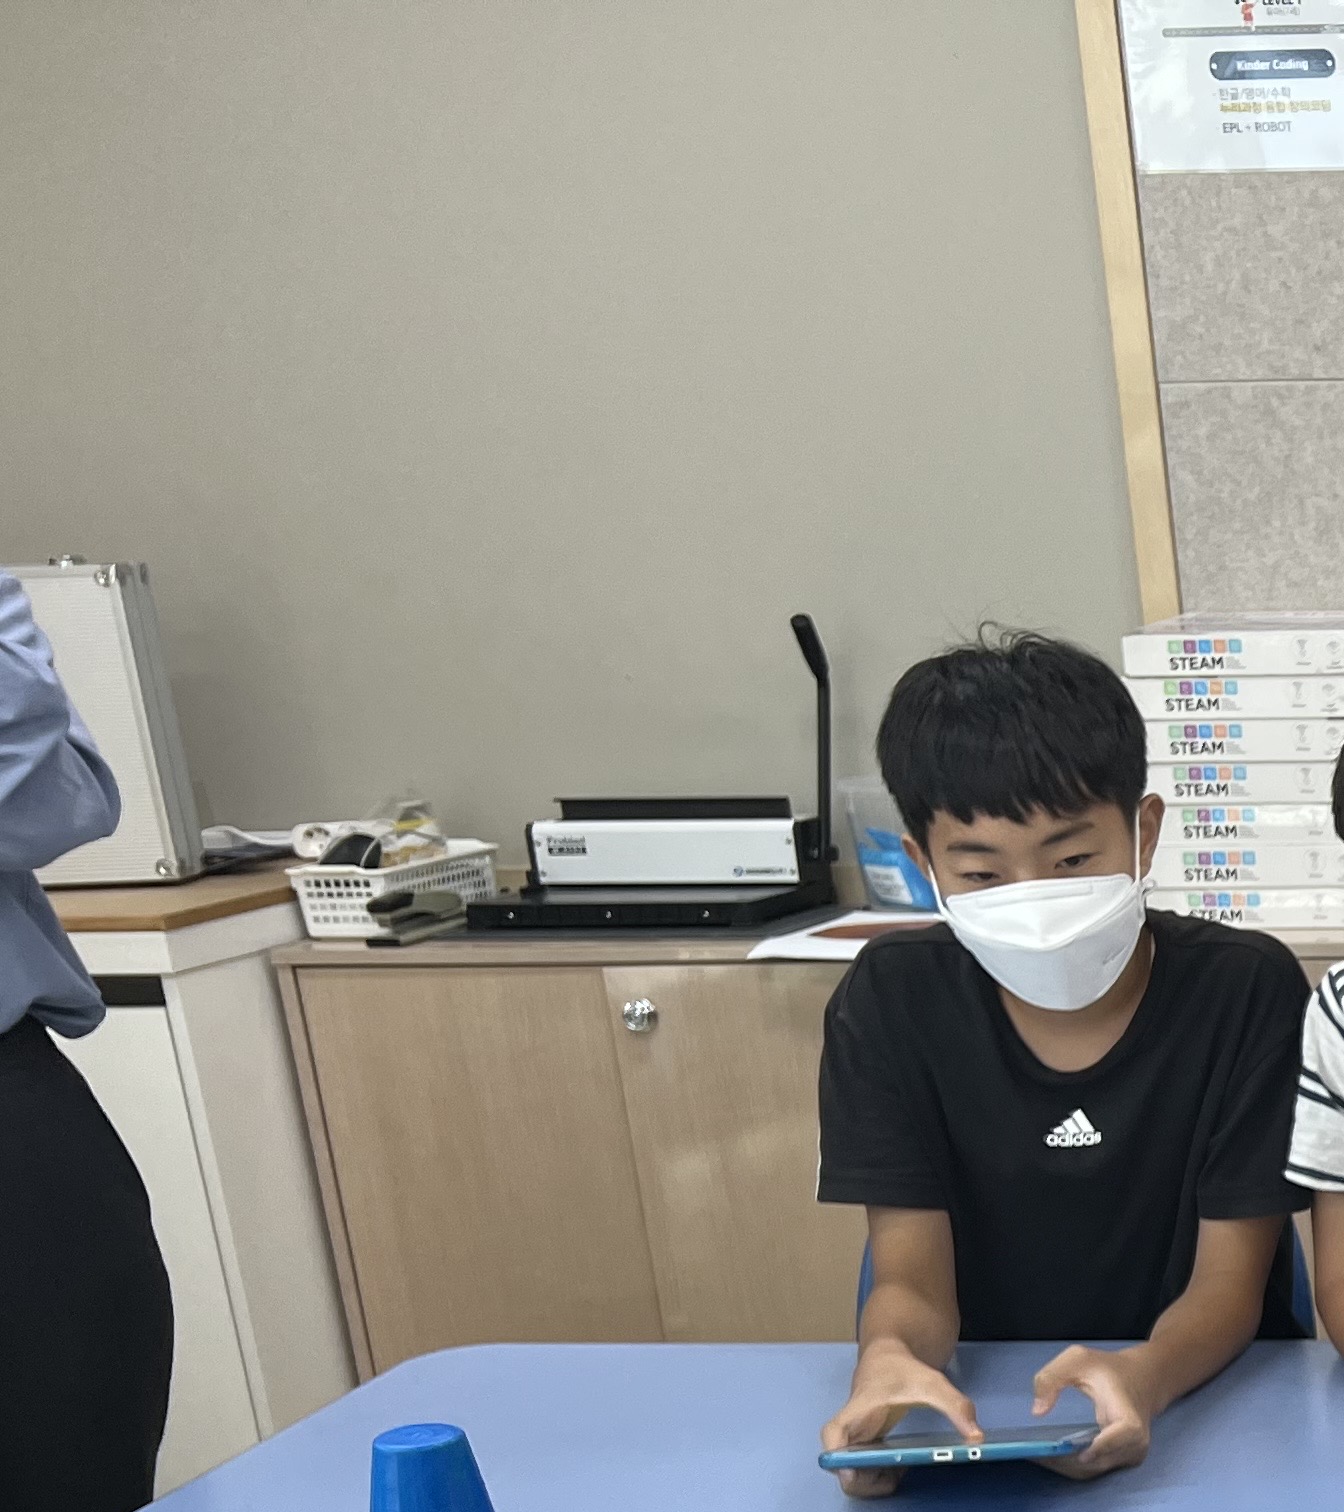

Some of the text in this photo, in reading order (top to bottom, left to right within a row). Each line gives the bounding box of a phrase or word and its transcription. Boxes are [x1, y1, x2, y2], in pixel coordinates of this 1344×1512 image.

[1272, 59, 1309, 71] Coding
[1222, 122, 1243, 133] EPL
[1254, 121, 1292, 133] ROBOT
[1169, 656, 1225, 671] STEAM
[1165, 698, 1220, 712] STEAM
[1170, 741, 1225, 755] STEAM
[1174, 783, 1229, 797] STEAM
[1183, 825, 1238, 839] STEAM
[1184, 868, 1238, 882] STEAM
[1044, 1131, 1102, 1148] adidas
